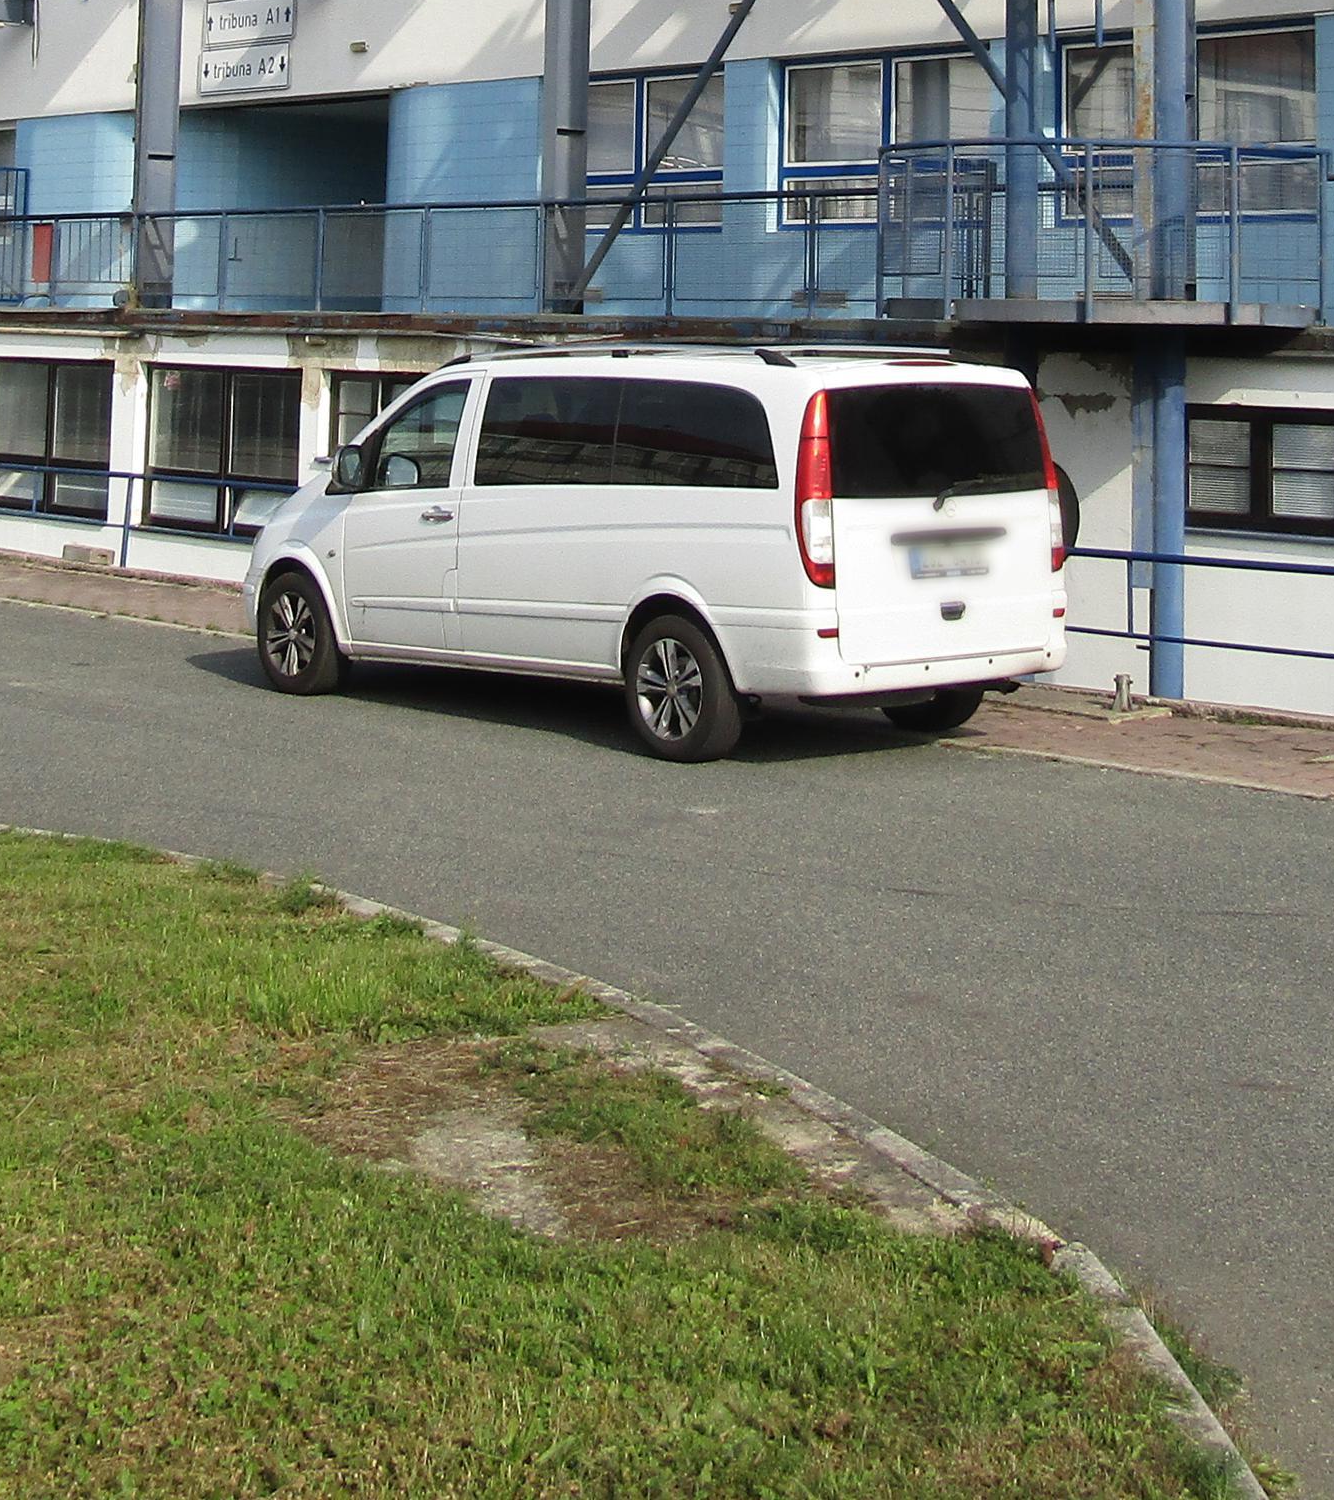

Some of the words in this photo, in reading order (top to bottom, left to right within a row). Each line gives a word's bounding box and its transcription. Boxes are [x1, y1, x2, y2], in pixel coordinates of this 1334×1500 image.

[219, 13, 258, 30] tribuna
[265, 6, 280, 25] A1
[213, 61, 252, 79] tribuna
[258, 56, 275, 75] A2
